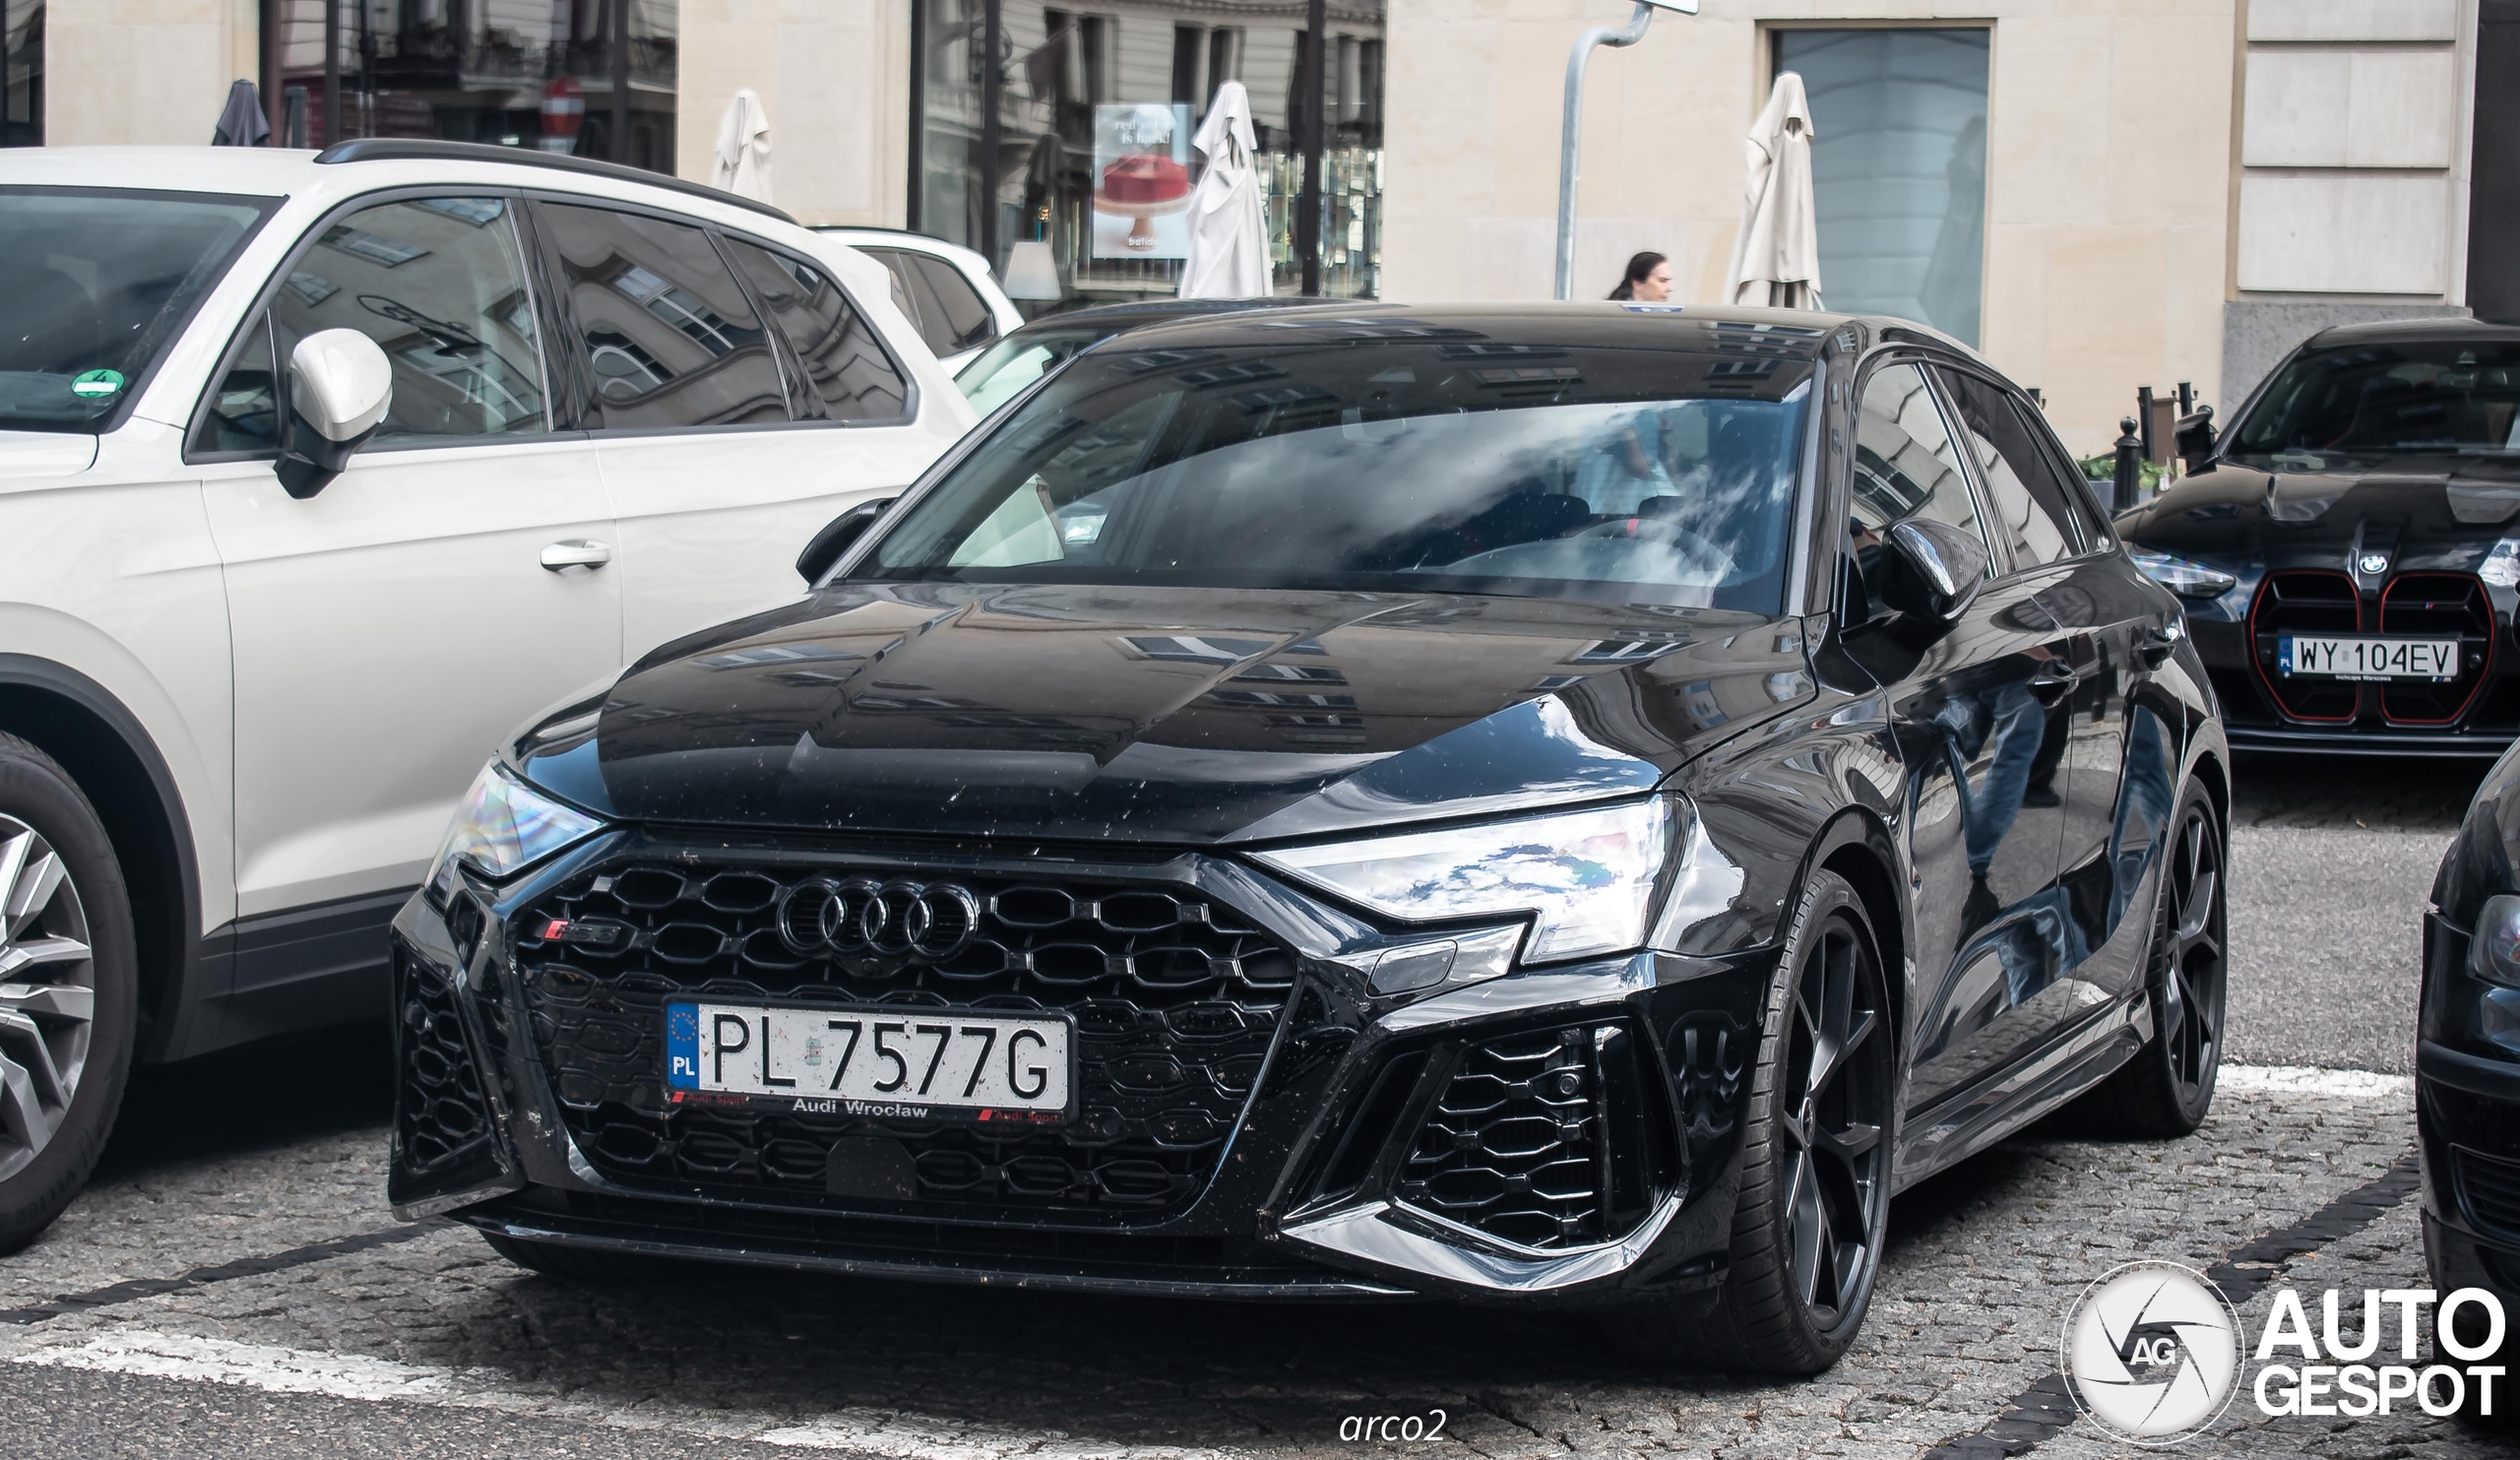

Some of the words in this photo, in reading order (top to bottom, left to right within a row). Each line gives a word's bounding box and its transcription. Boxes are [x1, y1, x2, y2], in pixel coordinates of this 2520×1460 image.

[1114, 118, 1136, 130] red
[1121, 131, 1133, 145] is
[92, 370, 107, 383] 4
[2280, 658, 2292, 667] PL
[2300, 641, 2339, 671] WY
[2354, 643, 2450, 673] 104EV
[714, 1013, 797, 1088] PL
[827, 1019, 1050, 1101] 7577G
[672, 1056, 695, 1077] PL
[686, 1092, 712, 1104] Audi
[716, 1094, 745, 1107] Sport
[792, 1098, 837, 1114] Audi
[846, 1100, 928, 1118] Wrocław
[994, 1110, 1023, 1121] Audi
[1027, 1111, 1059, 1123] Sport
